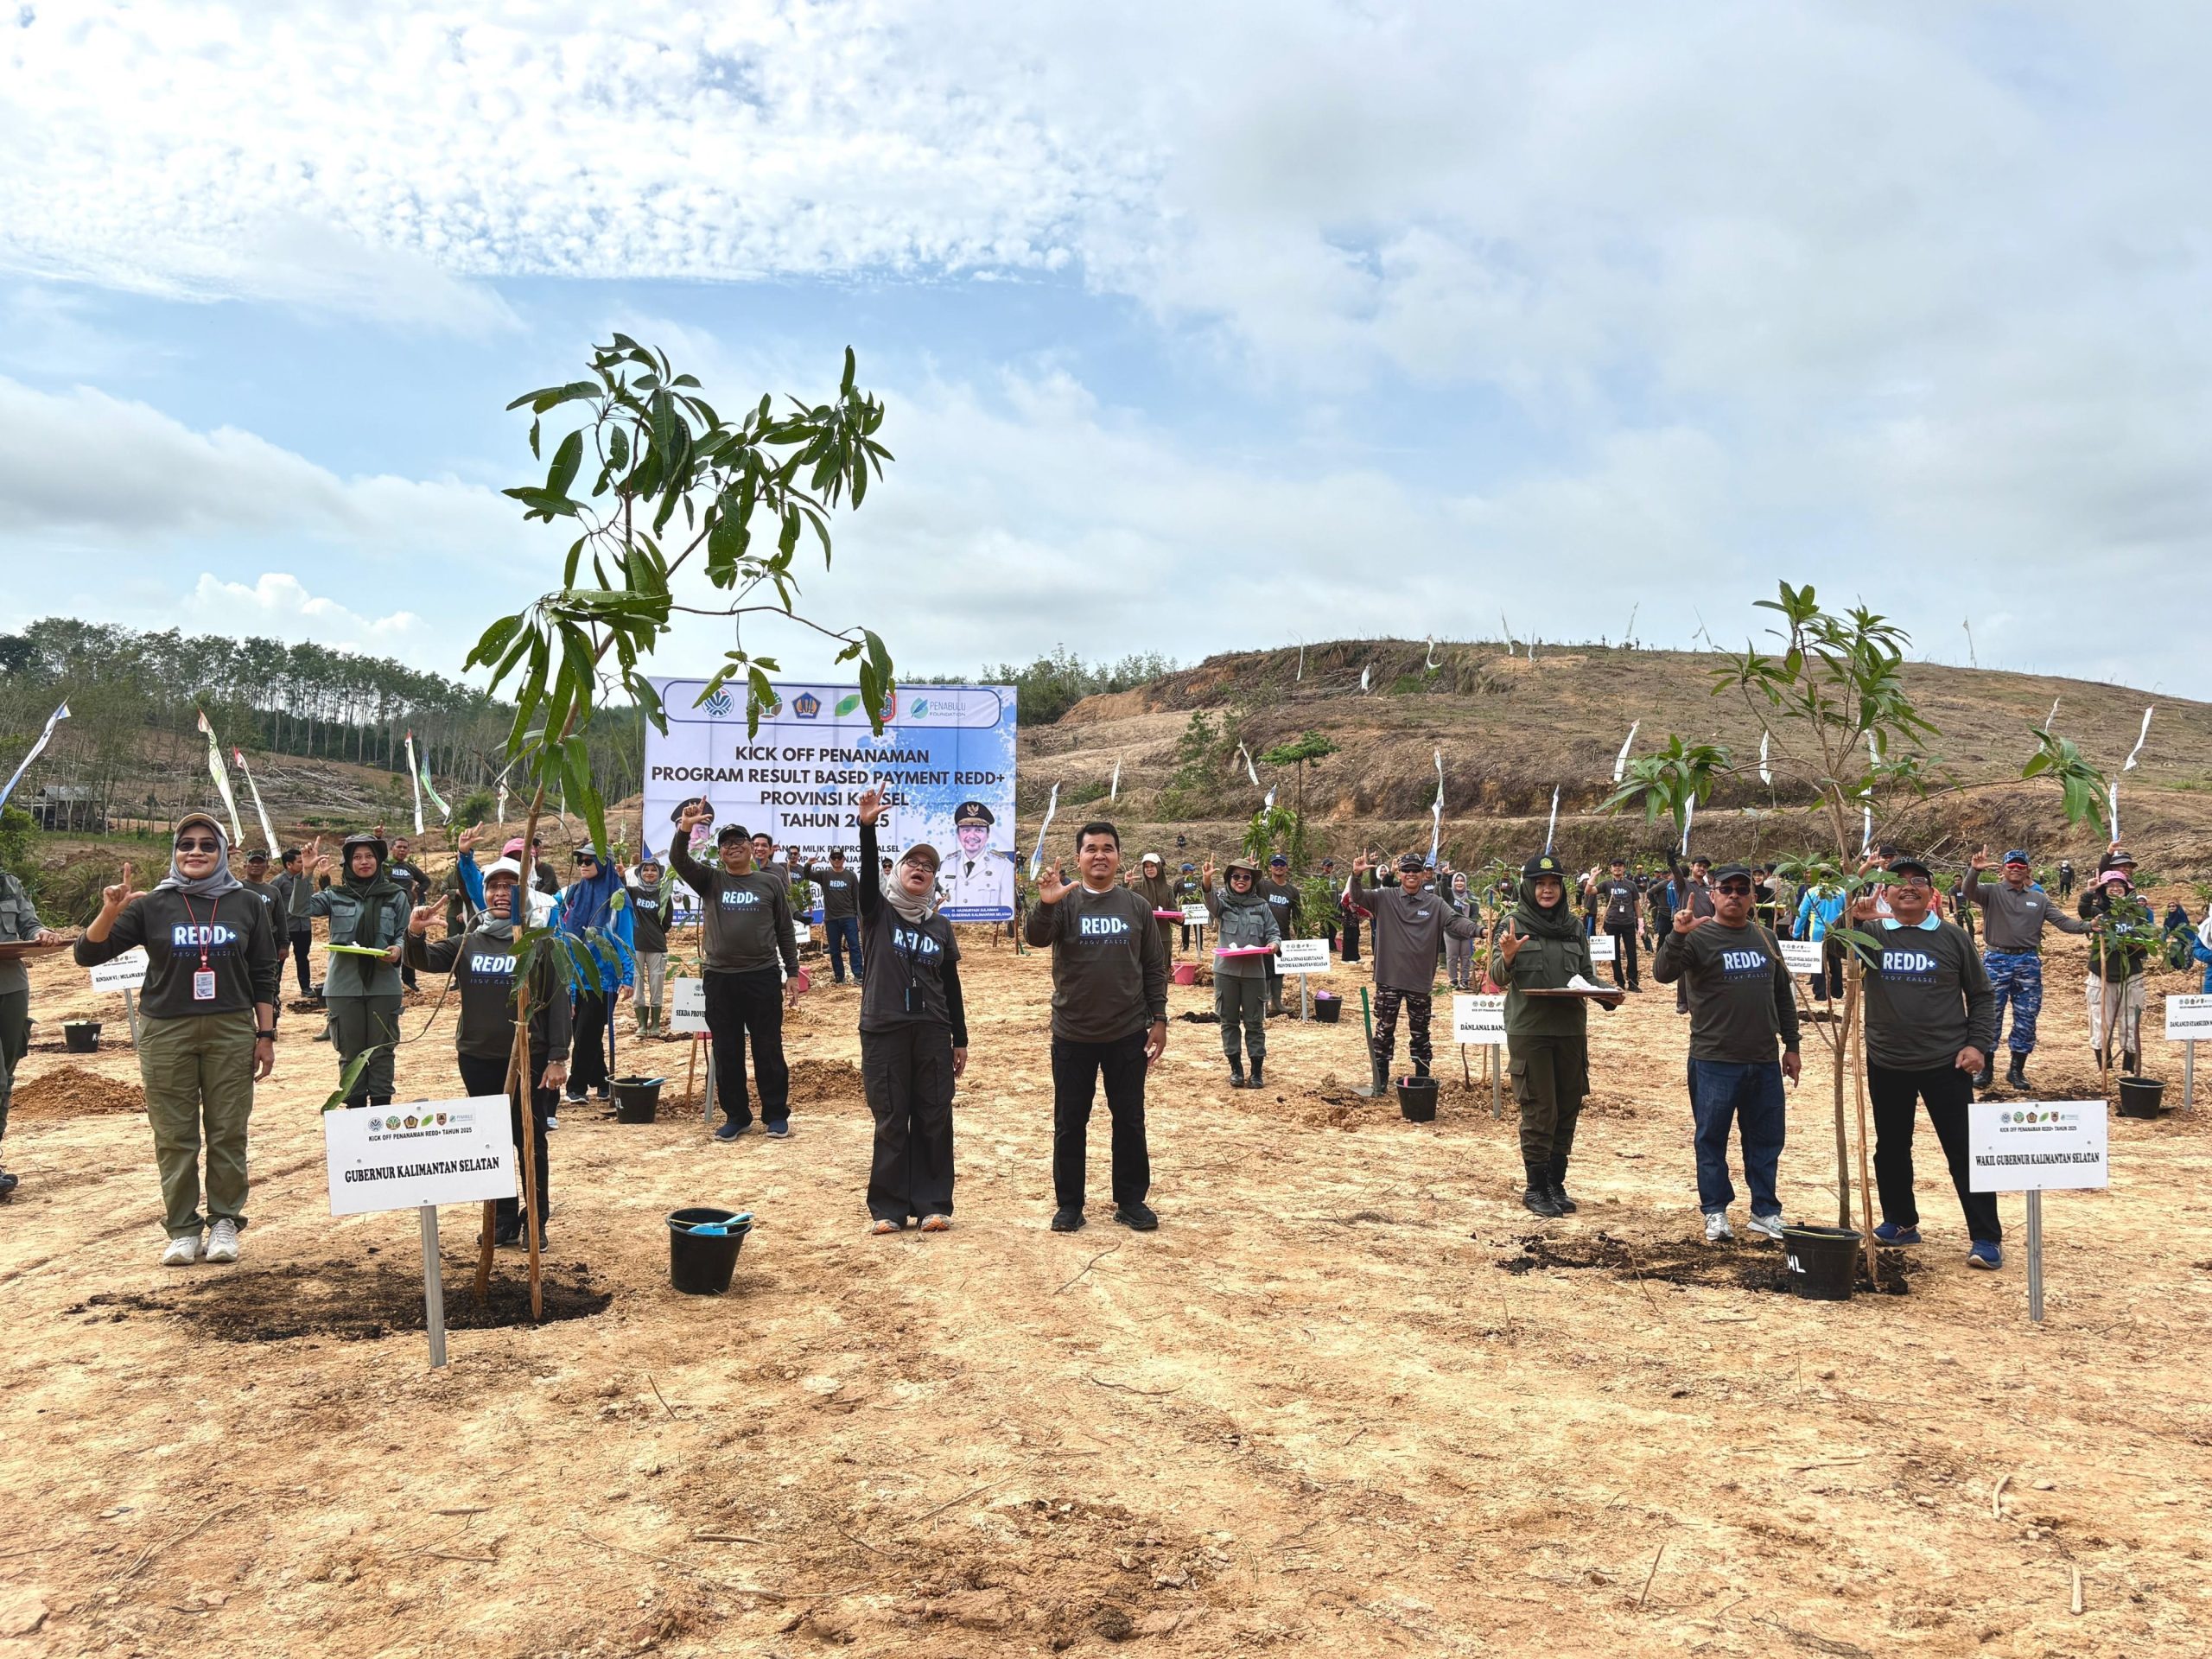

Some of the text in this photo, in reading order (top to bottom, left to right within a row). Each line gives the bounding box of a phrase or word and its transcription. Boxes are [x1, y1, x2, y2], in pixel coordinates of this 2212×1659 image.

[930, 701, 966, 711] PENABULU
[735, 746, 930, 764] KICK OFF PENANAMAN
[652, 766, 1005, 785] PROGRAM RESULT BASED PAYMENT REDD+
[760, 791, 909, 806] PROVINSI KSEL
[780, 812, 839, 828] TAHUN
[802, 844, 825, 853] MILIK
[636, 897, 659, 909] REDD+
[721, 891, 760, 904] REDD+
[1268, 893, 1290, 905] REDD+
[1082, 917, 1128, 935] REDD+
[174, 925, 237, 945] REDD+
[471, 955, 517, 973] REDD
[1722, 950, 1767, 969] REDD+
[1883, 952, 1936, 971] REDD+
[393, 1131, 424, 1140] PENANAMAN
[1975, 1152, 2100, 1166] WAKIL GUBERNUR KALIMANTAN SELATAN
[345, 1156, 499, 1183] GUBERNUR KALIMANTAN SELATAN
